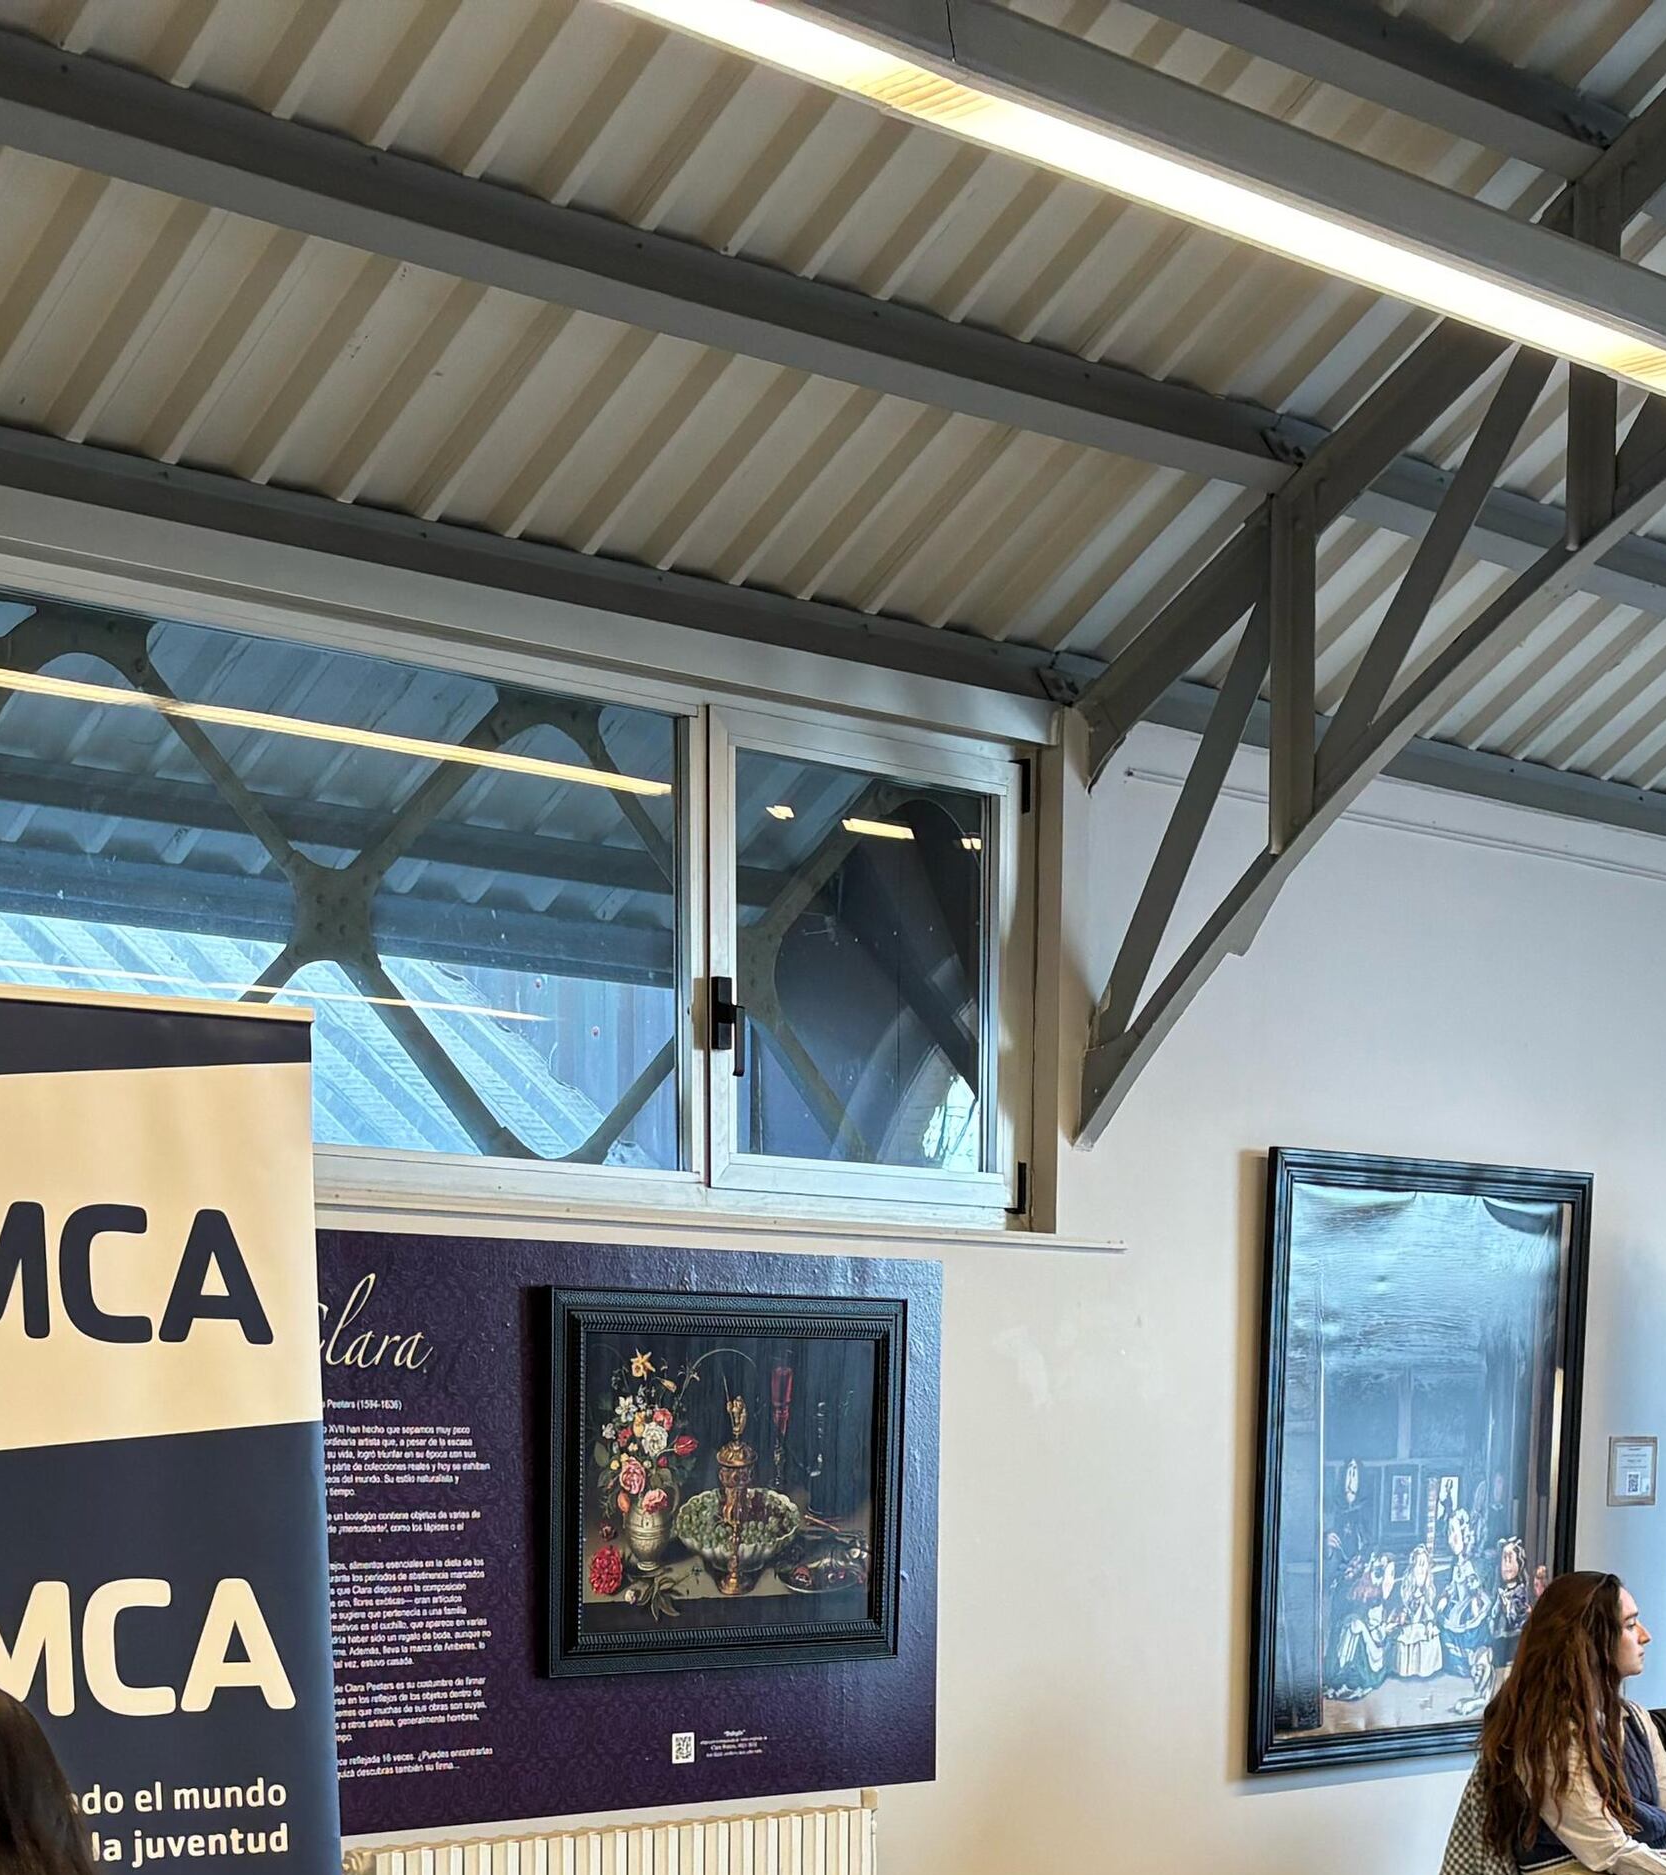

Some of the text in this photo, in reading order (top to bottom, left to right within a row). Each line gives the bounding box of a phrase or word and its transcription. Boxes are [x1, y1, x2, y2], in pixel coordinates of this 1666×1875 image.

[135, 1781, 162, 1811] el
[173, 1777, 287, 1810] mundo
[133, 1824, 288, 1868] juventud
